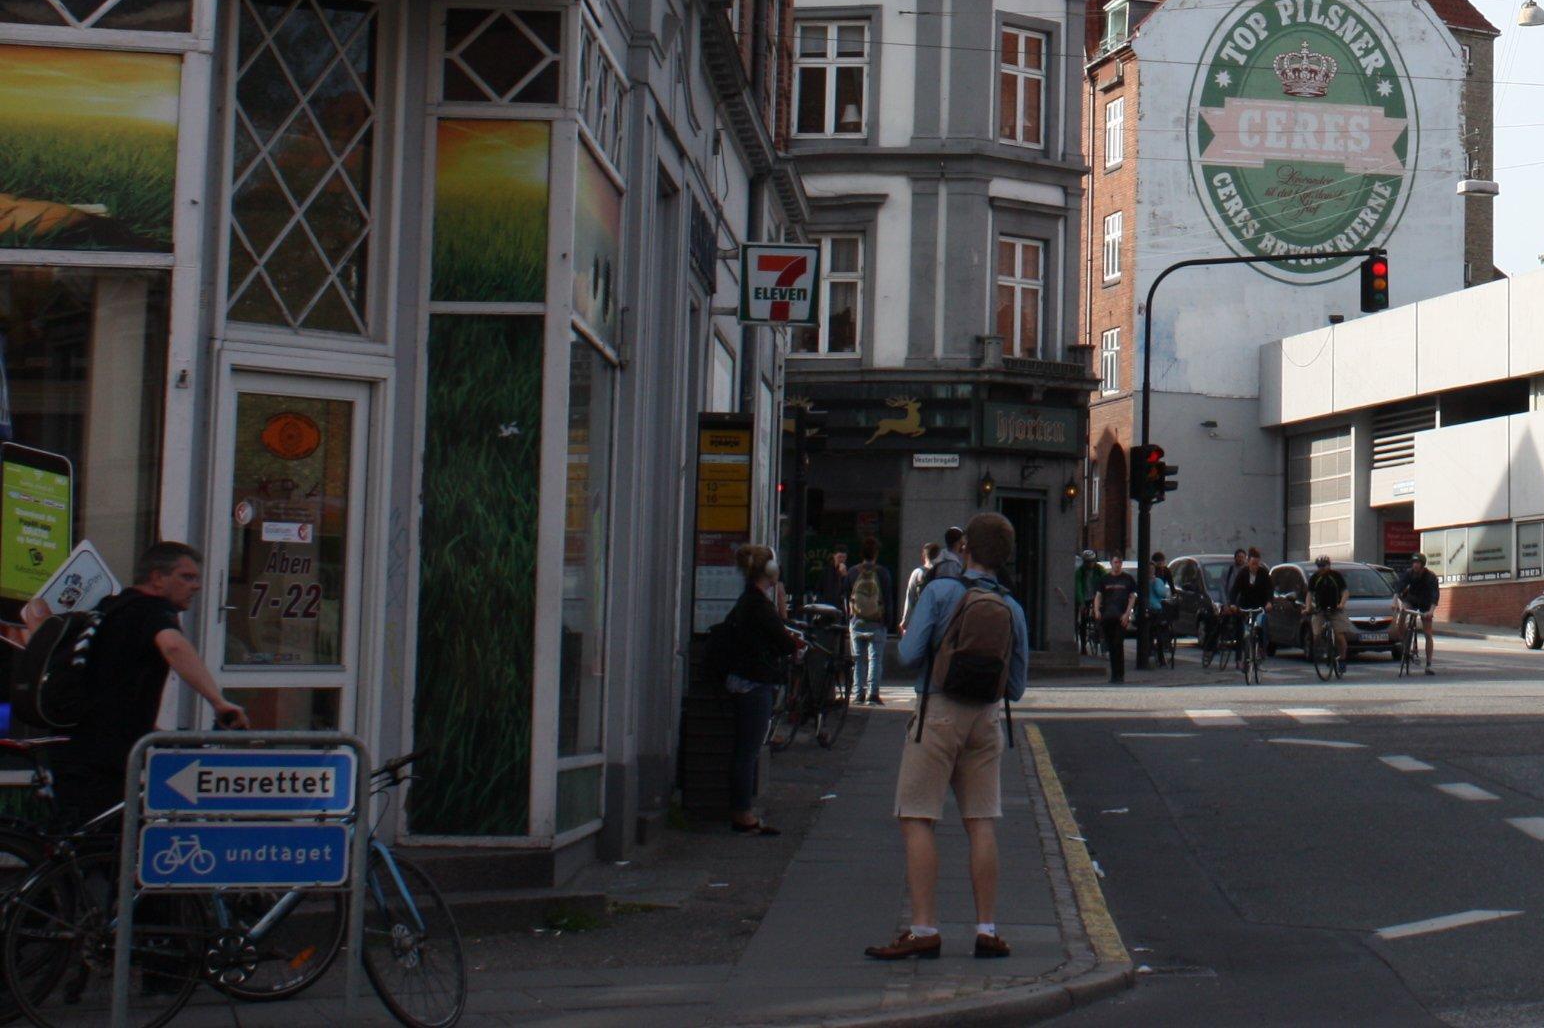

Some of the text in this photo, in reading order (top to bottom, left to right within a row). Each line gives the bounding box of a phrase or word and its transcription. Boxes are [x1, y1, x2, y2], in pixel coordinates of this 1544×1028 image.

[1220, 16, 1270, 67] TOP
[1238, 108, 1371, 152] CERES
[1212, 171, 1261, 239] CERES
[266, 543, 311, 575] Åben
[249, 582, 322, 619] 7-22
[196, 769, 331, 796] Ensrettet
[225, 843, 333, 865] undtaget
